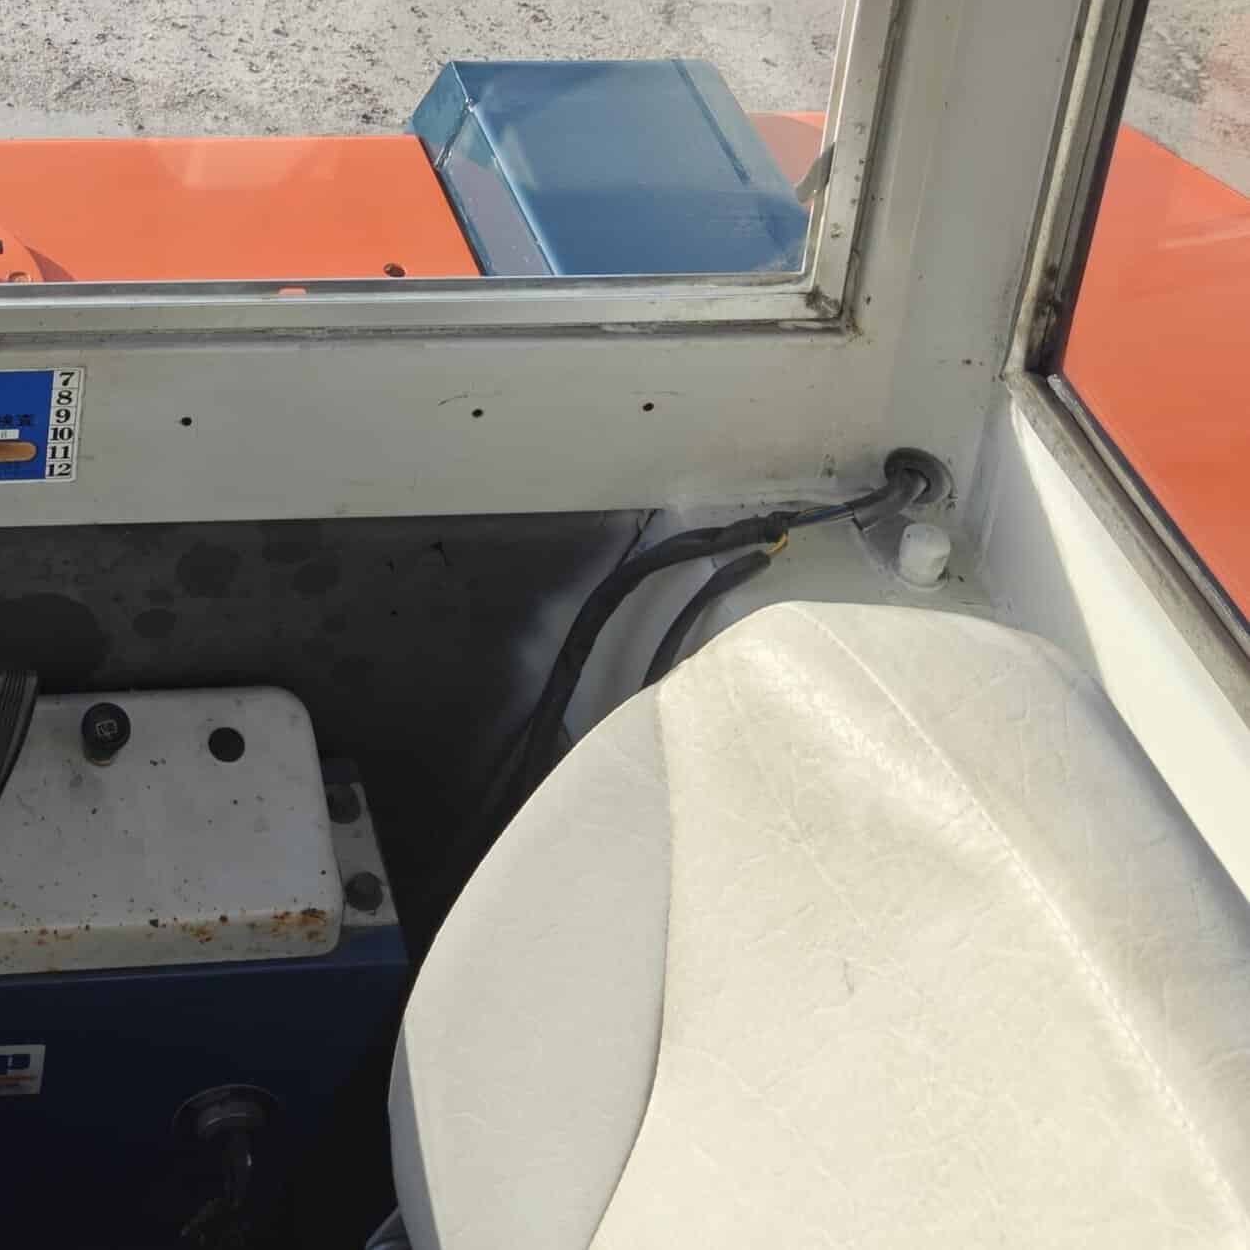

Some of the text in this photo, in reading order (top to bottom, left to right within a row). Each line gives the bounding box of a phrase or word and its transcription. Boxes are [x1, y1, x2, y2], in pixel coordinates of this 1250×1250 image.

[59, 372, 76, 387] 7
[56, 390, 73, 405] 8
[55, 408, 71, 424] 9
[51, 427, 74, 442] 10
[48, 445, 70, 460] 11
[46, 463, 71, 478] 12
